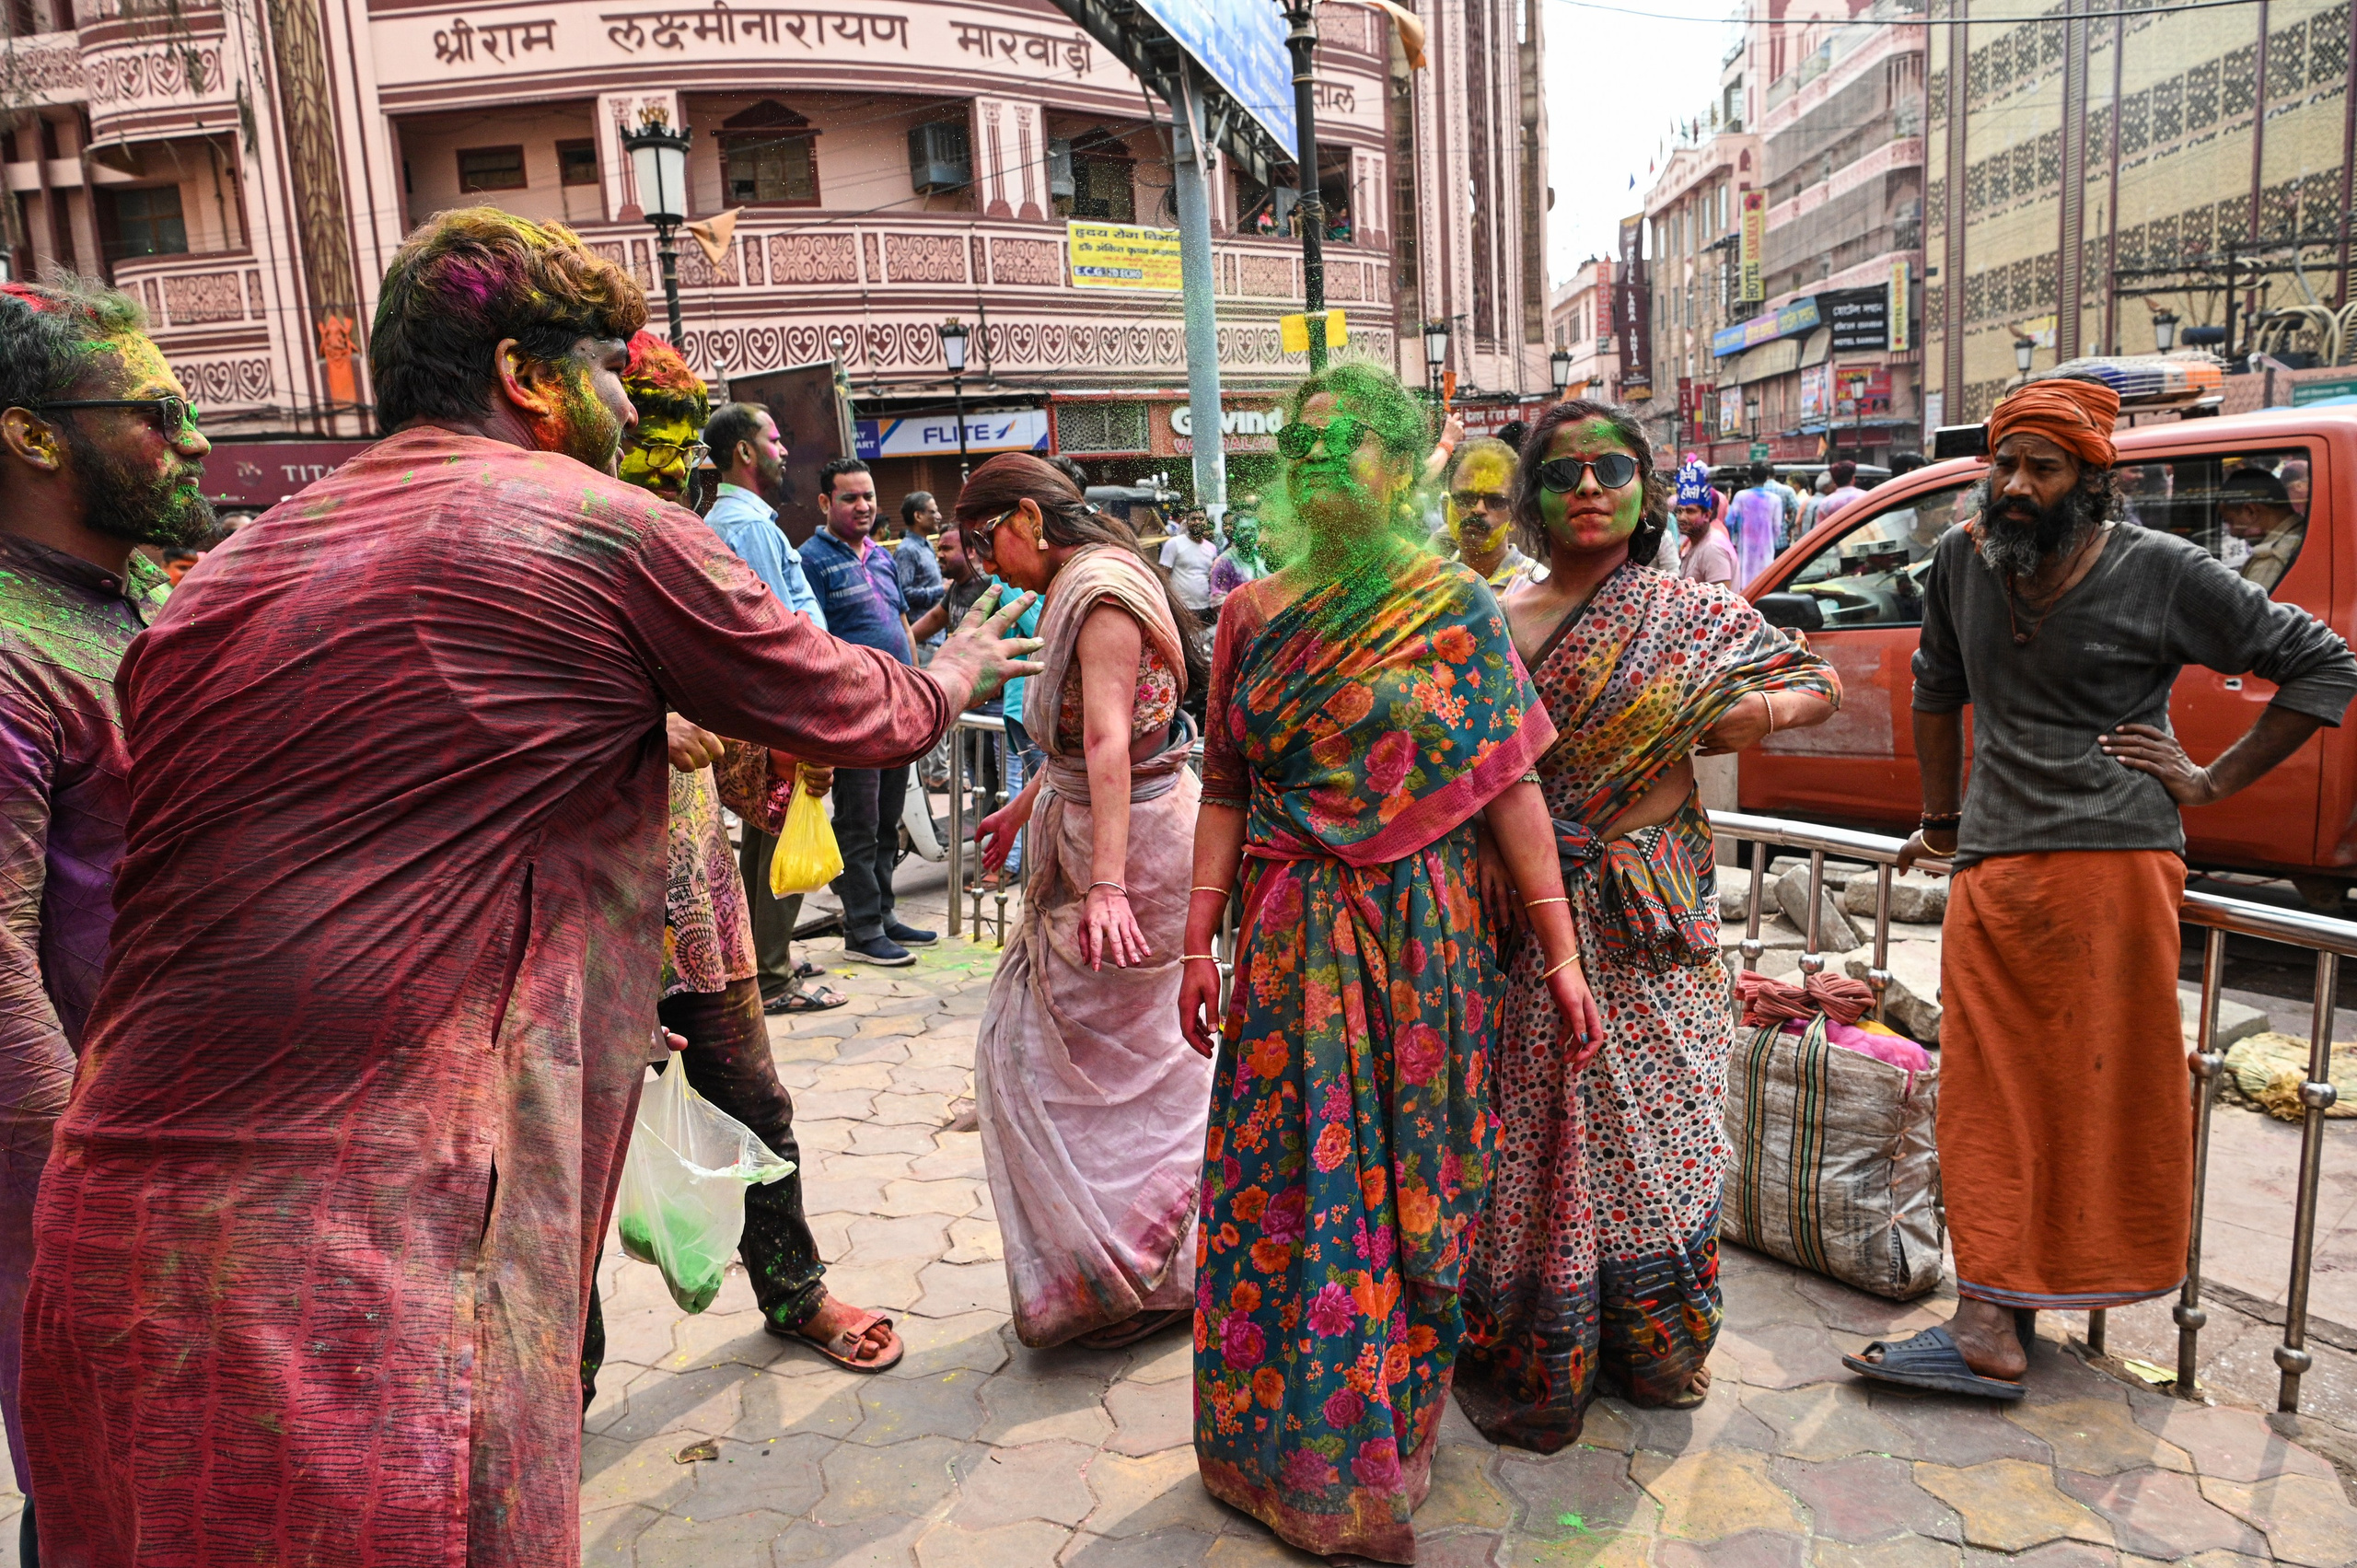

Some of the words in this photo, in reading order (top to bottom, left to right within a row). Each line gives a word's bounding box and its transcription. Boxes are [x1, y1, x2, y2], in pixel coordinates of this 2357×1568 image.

[599, 0, 908, 52] लक्ष्मीनारायण
[949, 20, 1091, 79] मारवाड़ी
[1113, 228, 1139, 238] रोग
[1627, 245, 1636, 285] HOTEL
[1746, 262, 1759, 298] HOTEL
[1628, 290, 1637, 322] LARA
[923, 424, 990, 444] FLITE
[1170, 406, 1283, 436] Gvind
